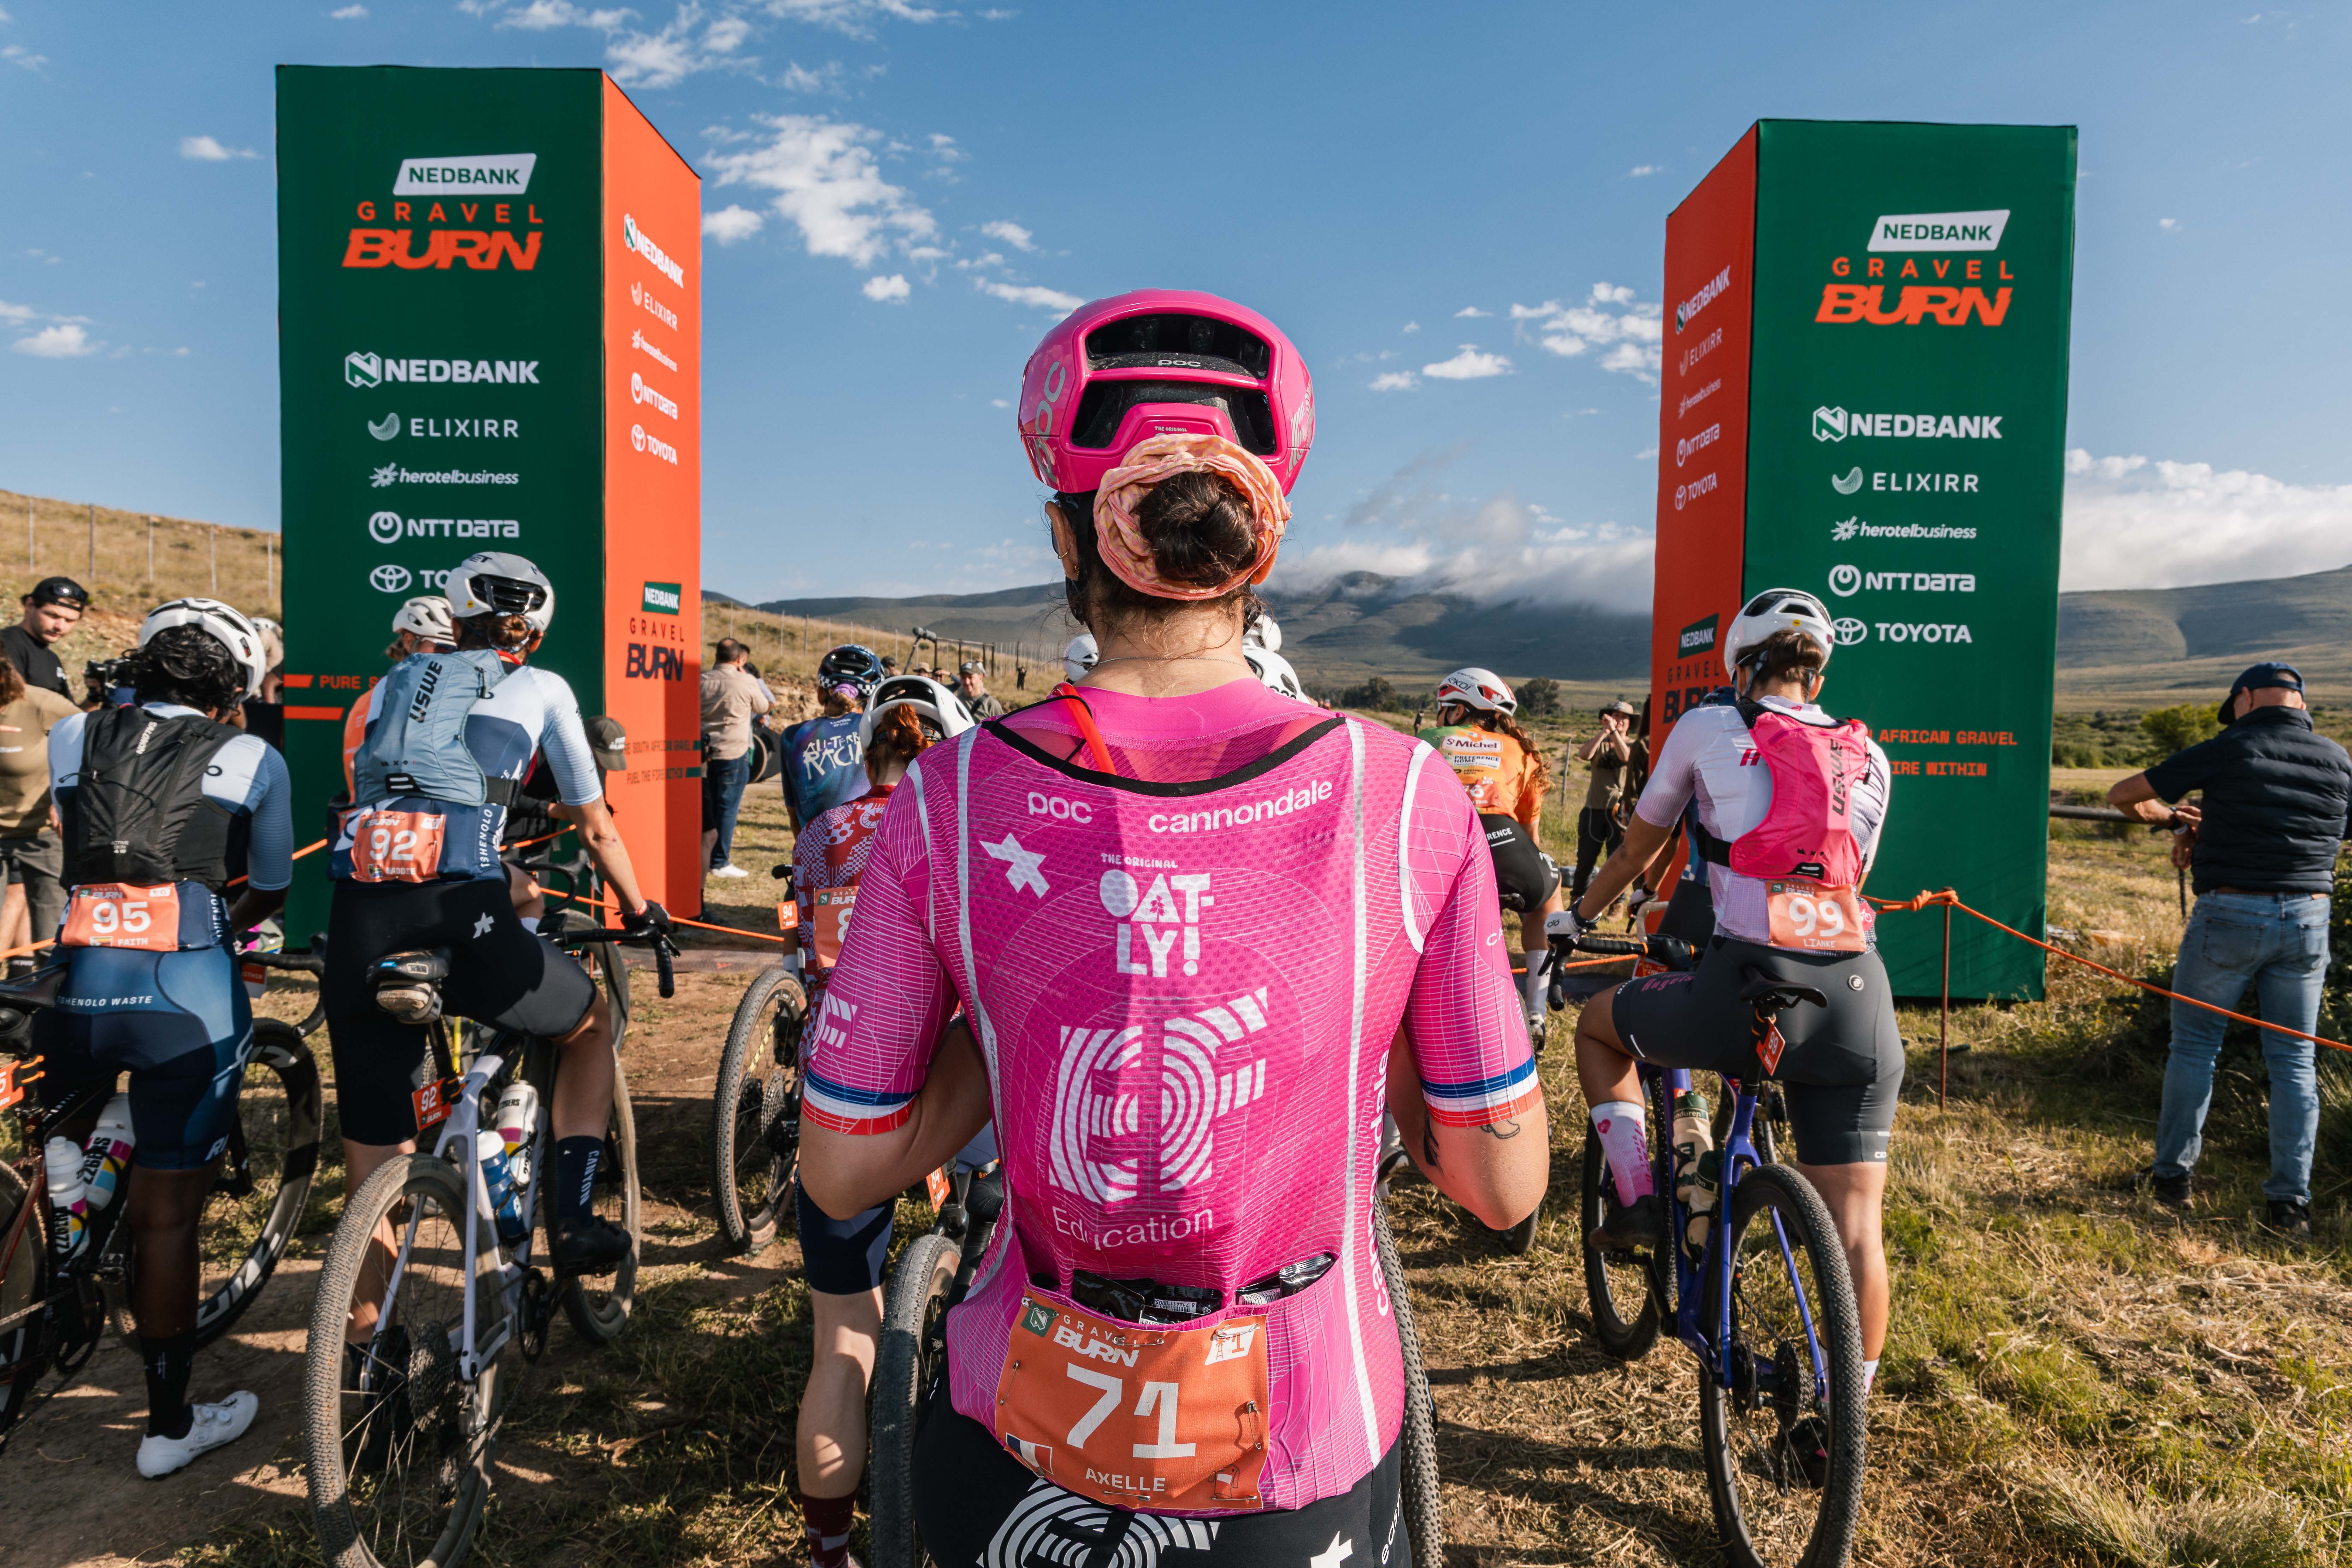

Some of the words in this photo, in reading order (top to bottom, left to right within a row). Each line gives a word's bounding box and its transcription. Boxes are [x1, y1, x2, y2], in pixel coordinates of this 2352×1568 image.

[409, 166, 520, 185] NEDBANK
[358, 201, 543, 224] GRAVEL
[1883, 223, 1992, 241] NEDBANK
[342, 228, 543, 270] BURN
[636, 229, 683, 288] NEDBANK
[1832, 257, 2014, 279] GRAVEL
[1685, 265, 1730, 322] NEDBANK
[1815, 283, 2013, 326] BURN
[644, 291, 677, 331] ELIXIRR
[1690, 328, 1722, 366] ELIXIRR
[385, 359, 540, 384] NEDBANK
[410, 418, 519, 438] ELIXIRR
[1851, 413, 2003, 439] NEDBANK
[647, 435, 677, 465] TOYOTA
[400, 468, 519, 484] herotelbusiness
[1688, 472, 1717, 501] TOYOTA
[1873, 473, 1978, 493] ELIXIRR
[407, 519, 454, 537] NTT
[1860, 522, 1976, 539] herotelbusiness
[1865, 572, 1911, 590] NTT
[645, 587, 679, 609] NEDBANK
[630, 618, 684, 642] GRAVEL
[1681, 627, 1713, 648] NEDBANK
[1875, 623, 1972, 643] TOYOTA
[626, 643, 684, 681] BURN
[1668, 660, 1719, 683] GRAVEL
[320, 675, 360, 689] PURE
[409, 661, 442, 723] USWE
[1455, 740, 1497, 749] Michel
[1879, 730, 1949, 744] AFRICAN
[1956, 731, 2017, 745] GRAVEL
[1890, 761, 1920, 775] IRE
[1926, 762, 1987, 776] WITHIN
[1149, 779, 1333, 834] cannondale
[370, 829, 417, 861] 92
[1486, 828, 1513, 841] RENCE
[1101, 853, 1122, 865] THE
[1125, 856, 1178, 868] ORIGINAL
[831, 896, 856, 905] BUR
[1786, 888, 1815, 898] BURN
[92, 902, 151, 933] 95
[783, 904, 792, 919] 94
[1789, 897, 1844, 936] 99
[117, 938, 148, 947] FAITH
[1117, 925, 1200, 978] LY!
[1804, 938, 1836, 948] LIANKE
[1641, 975, 1695, 992] Angels
[111, 996, 152, 1006] WASTE
[1768, 1031, 1778, 1055] 99
[421, 1086, 437, 1112] 92
[427, 1112, 442, 1123] BURN
[579, 1150, 600, 1206] CANYON
[1053, 1206, 1213, 1251] Education
[1053, 1326, 1139, 1367] BURN
[1067, 1363, 1196, 1458] 71
[1085, 1468, 1165, 1492] AXELLE
